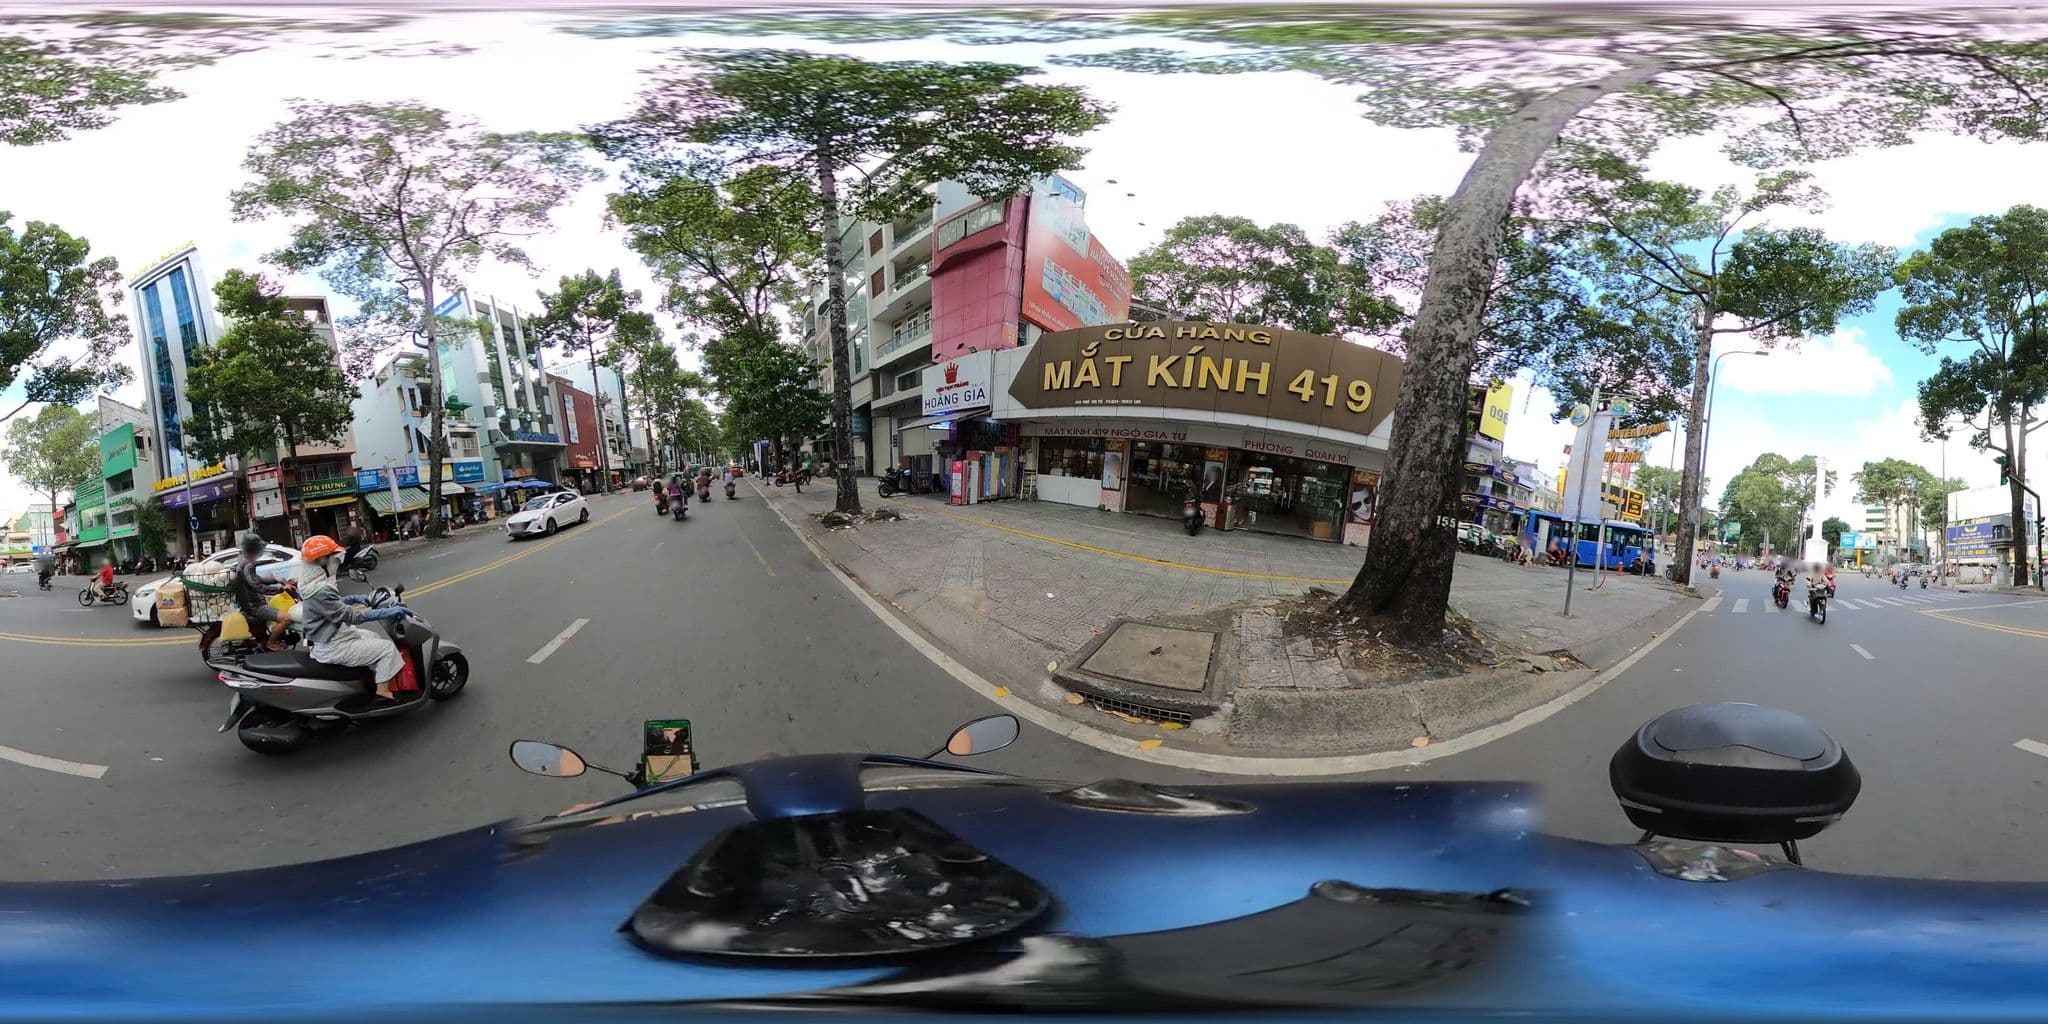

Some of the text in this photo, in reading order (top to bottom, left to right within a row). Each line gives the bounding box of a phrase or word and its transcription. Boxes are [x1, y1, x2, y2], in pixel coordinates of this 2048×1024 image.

[1104, 319, 1272, 345] CỬA HÀNG
[1043, 341, 1372, 413] MẮT KÍNH 419
[924, 392, 959, 409] HOÀNG
[964, 388, 986, 402] GIA
[1092, 428, 1108, 436] 419
[1144, 430, 1167, 439] GIA
[1338, 454, 1347, 463] 10
[1436, 515, 1456, 528] 155
